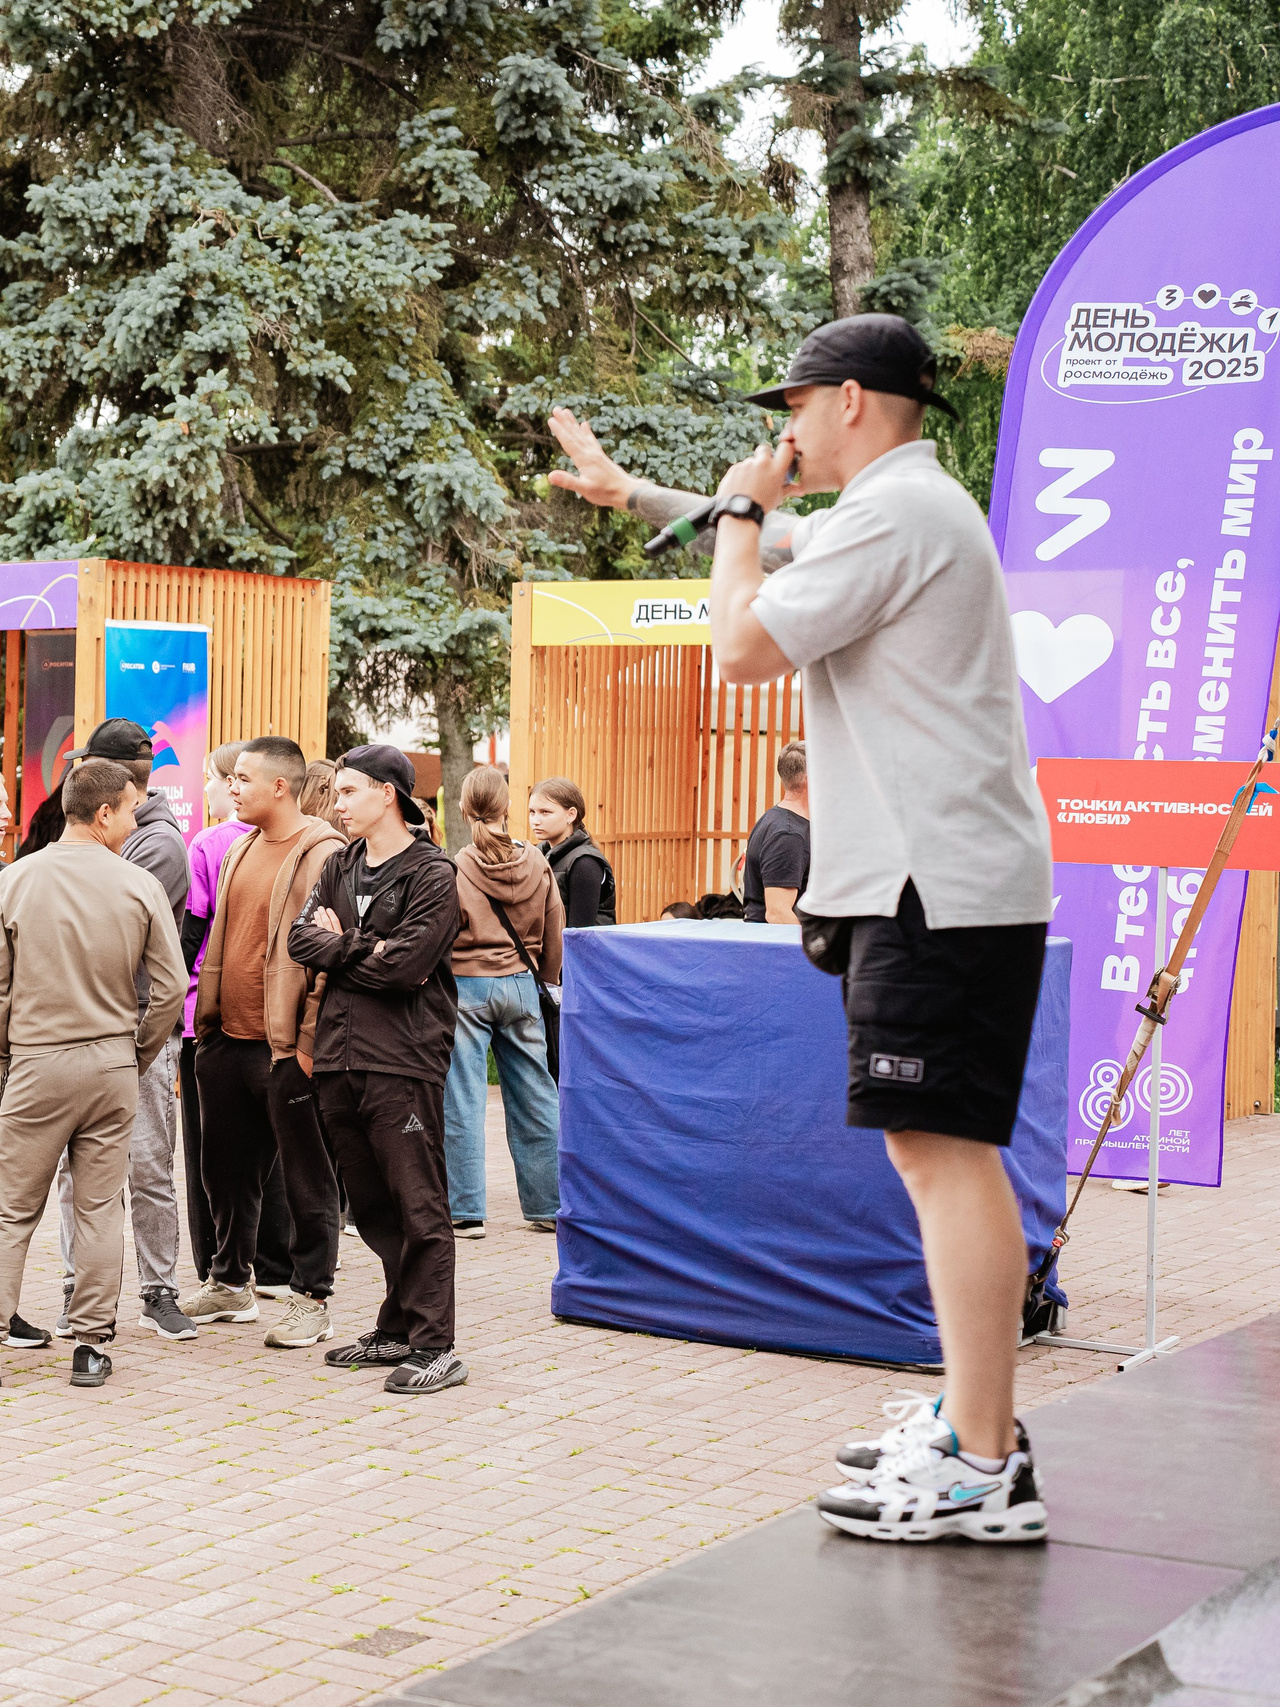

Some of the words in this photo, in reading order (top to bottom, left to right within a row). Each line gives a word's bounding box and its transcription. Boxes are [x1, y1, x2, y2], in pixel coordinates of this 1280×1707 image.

[1070, 307, 1150, 332] ДЕНЬ
[1067, 326, 1250, 357] МОЛОДЁЖИ
[1065, 357, 1103, 368] проект
[1105, 358, 1118, 366] от
[1188, 356, 1260, 381] 2025
[1063, 368, 1169, 383] росмолодёжь
[1191, 548, 1247, 762] менить
[1219, 427, 1274, 538] мир
[635, 603, 693, 624] ДЕНЬ
[1145, 557, 1196, 670] все,
[1133, 680, 1172, 761] сть
[1056, 812, 1131, 826] «ЛЮБИ»
[1057, 798, 1121, 812] ТОЧКИ
[1123, 800, 1274, 817] АКТИВНОСЕЙ
[1112, 864, 1153, 945] теб
[1100, 954, 1141, 994] В
[1074, 1138, 1190, 1154] ПРОМЫШЛЕНОСТИ
[1167, 1129, 1191, 1138] ЛЕТ
